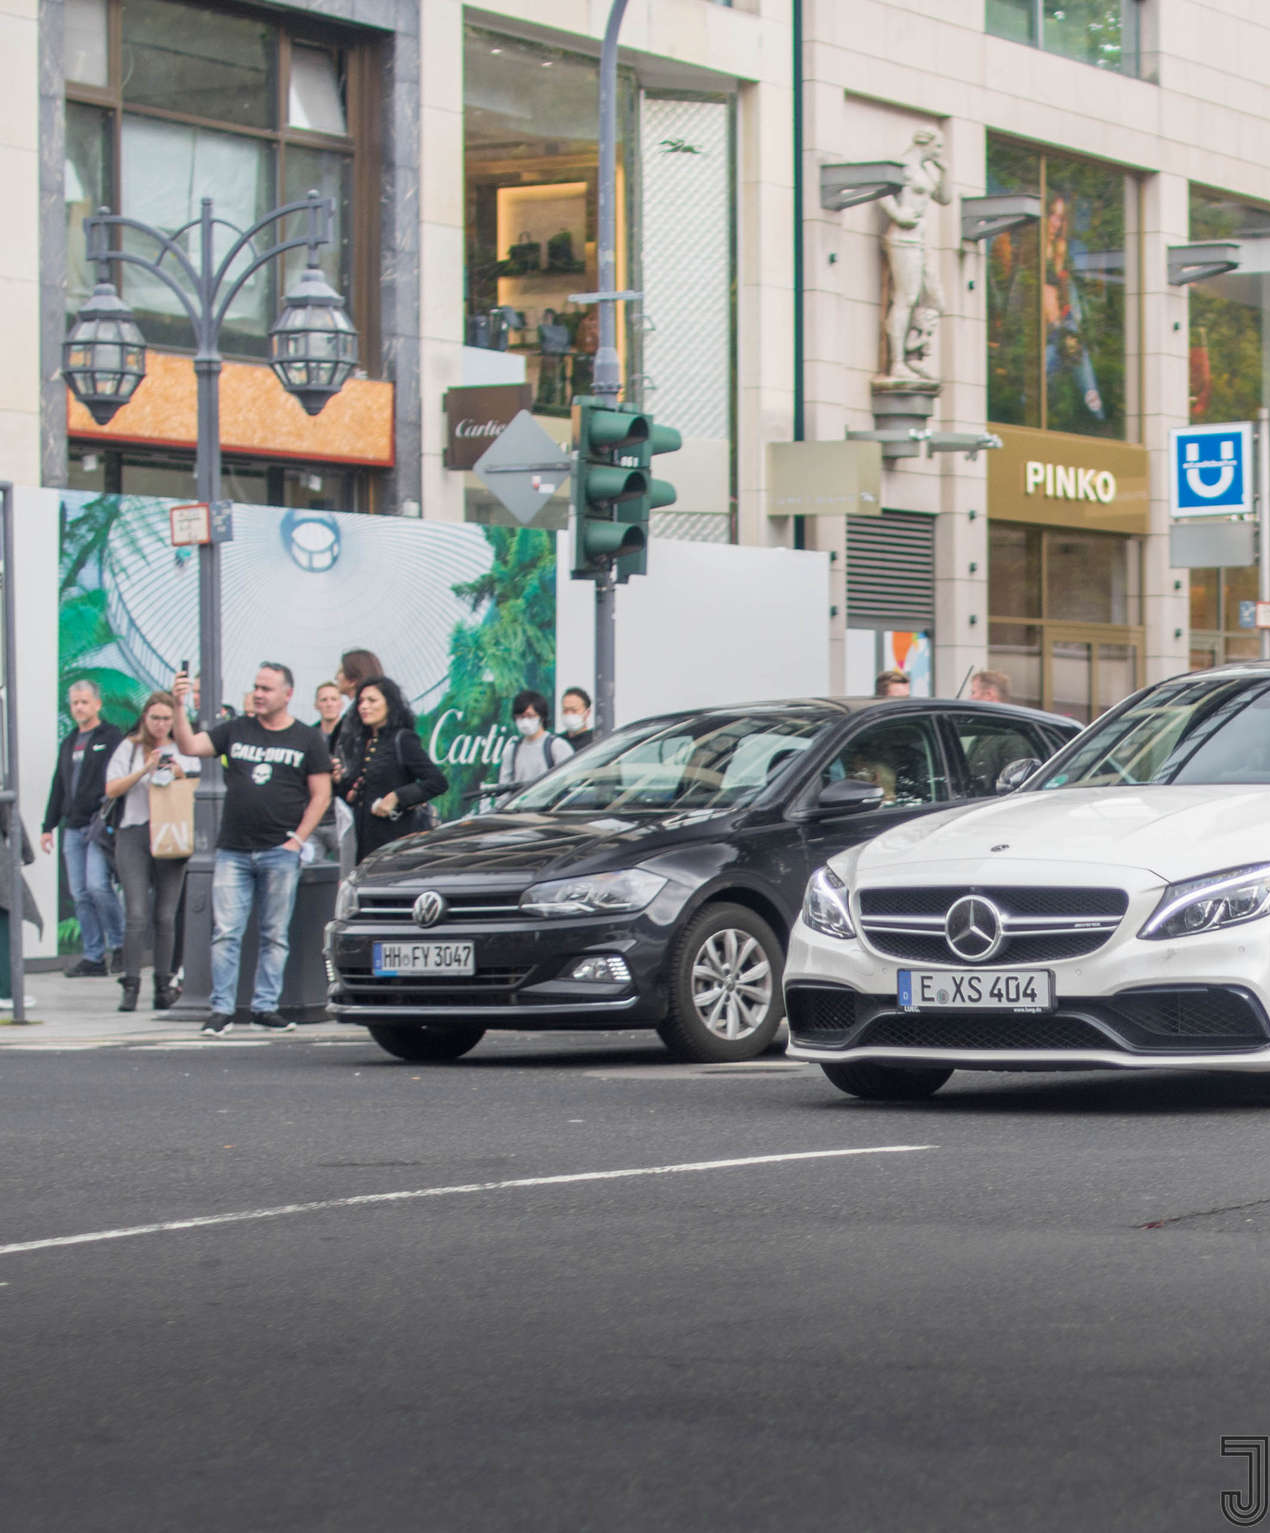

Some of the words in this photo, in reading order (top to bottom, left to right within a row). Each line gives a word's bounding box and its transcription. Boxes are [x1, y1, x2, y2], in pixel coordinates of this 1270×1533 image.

[455, 418, 505, 438] Cartie
[1025, 460, 1117, 504] PINKO
[230, 741, 262, 763] CALL
[264, 747, 304, 768] DUTY
[383, 946, 401, 968] HH
[412, 946, 430, 968] FY
[434, 945, 471, 967] 3047
[921, 976, 935, 1002] E
[952, 976, 982, 1003] XS
[989, 976, 1037, 1003] 404
